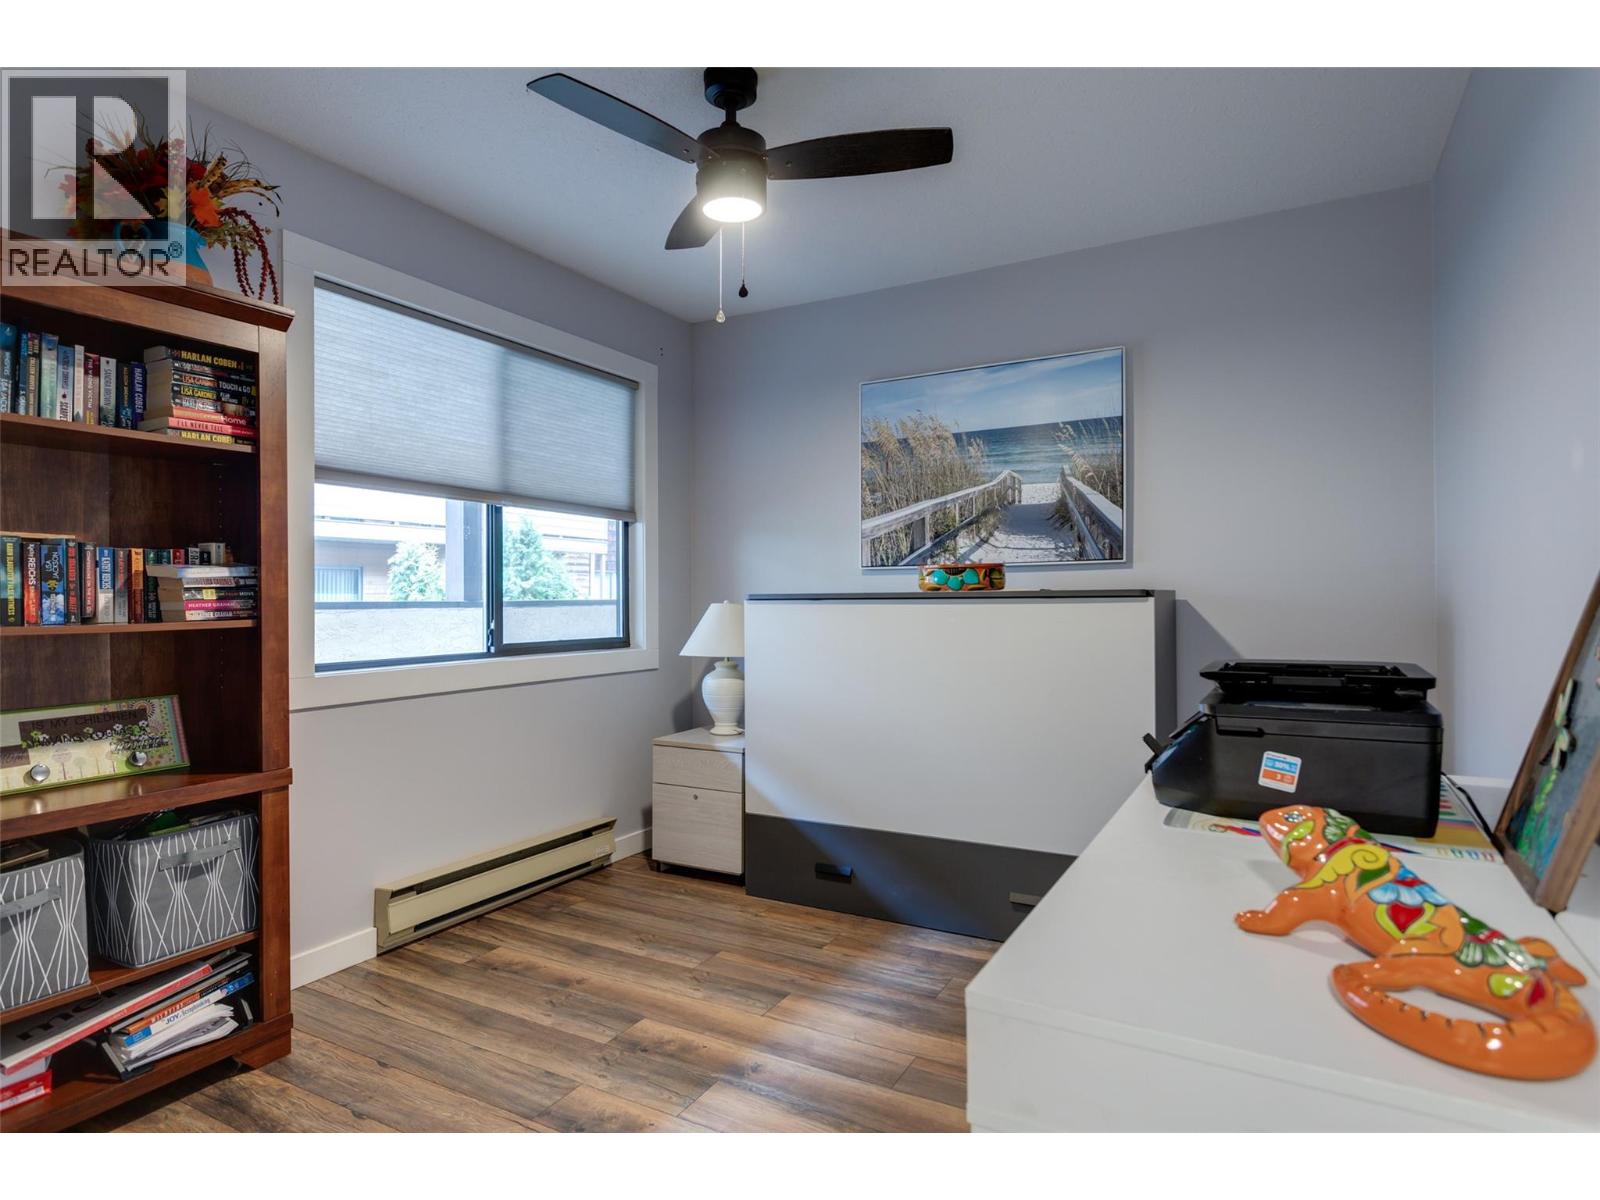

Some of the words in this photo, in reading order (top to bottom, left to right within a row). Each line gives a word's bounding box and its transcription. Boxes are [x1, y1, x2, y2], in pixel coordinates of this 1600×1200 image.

[181, 351, 212, 364] HARLAN
[213, 356, 237, 368] COBEN
[134, 367, 143, 392] HARLAN
[182, 374, 194, 384] LISA
[180, 386, 193, 396] LISA
[219, 381, 238, 392] TOUCH
[242, 385, 251, 393] GO
[134, 392, 144, 413] COBEN
[190, 421, 209, 430] NEVER
[210, 424, 223, 432] TELL
[181, 431, 212, 441] HARLAN
[212, 434, 235, 445] COBEN
[28, 557, 36, 585] REICHS
[74, 711, 139, 726] CHILDREN
[165, 1013, 180, 1025] JOY
